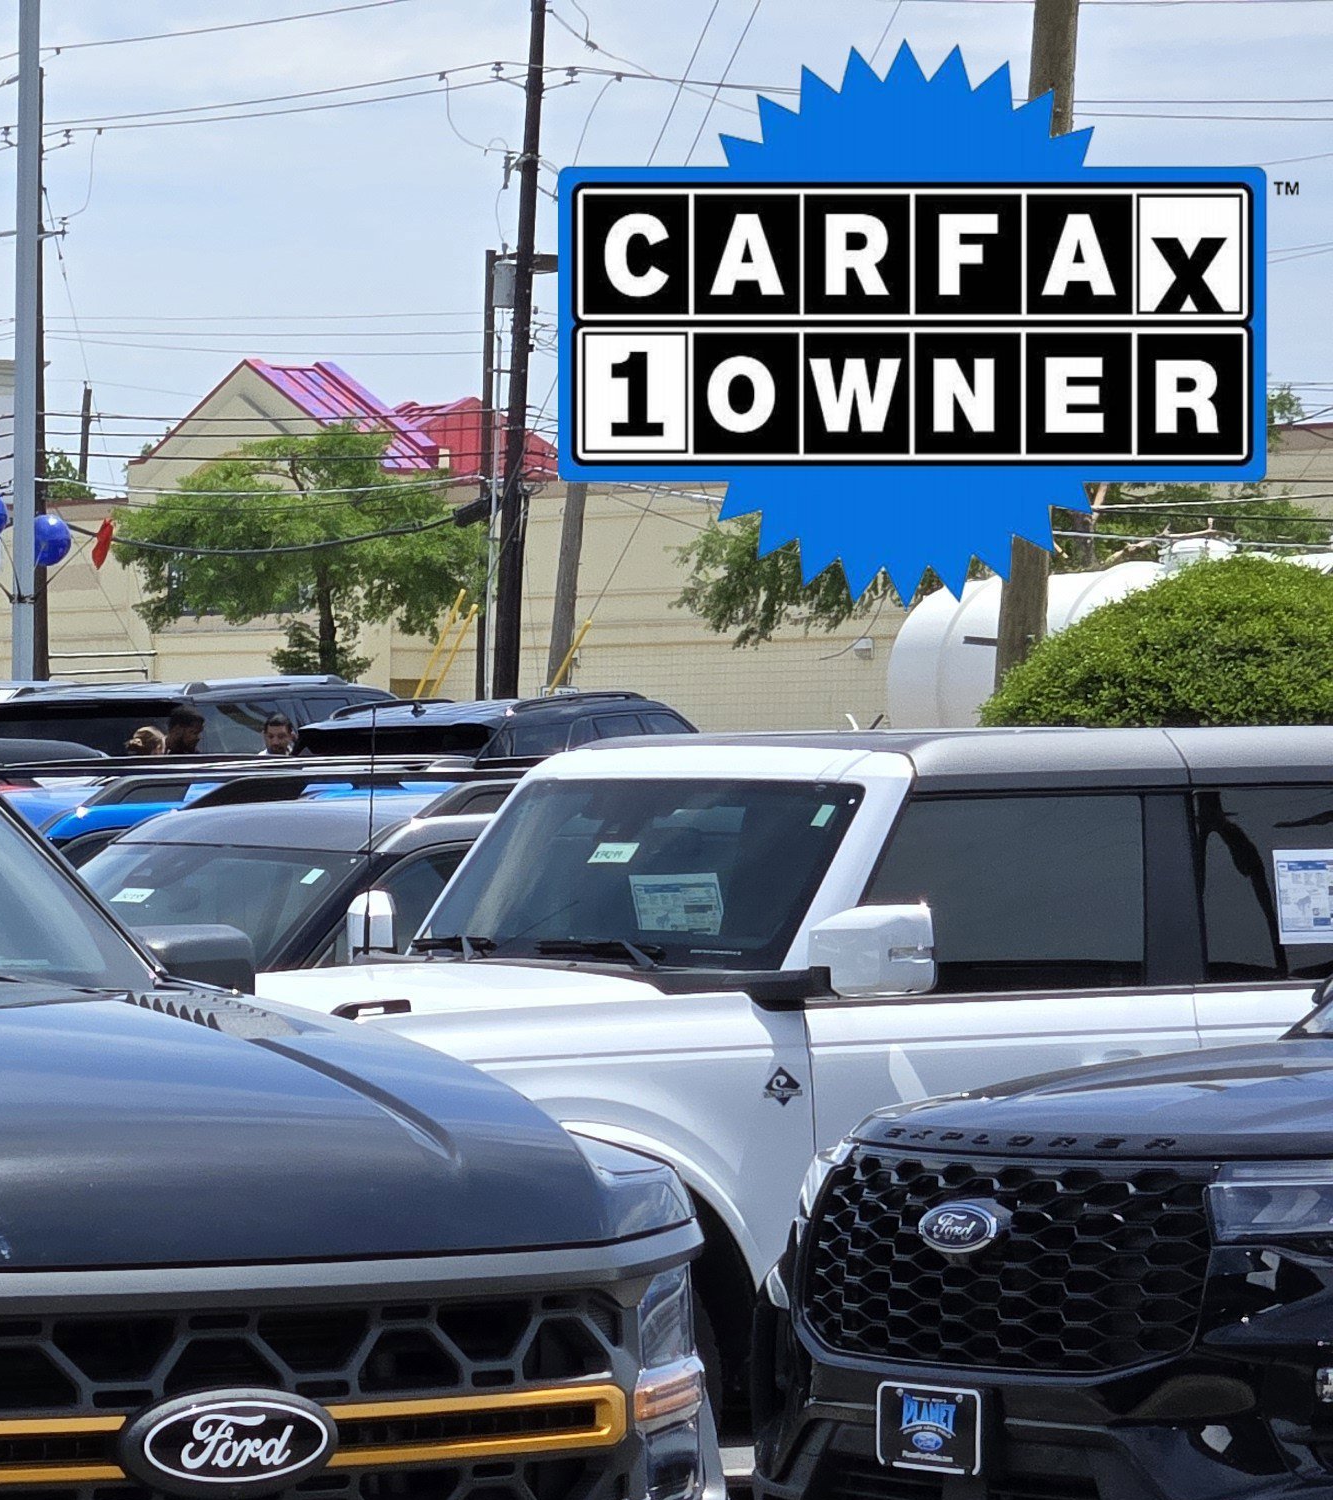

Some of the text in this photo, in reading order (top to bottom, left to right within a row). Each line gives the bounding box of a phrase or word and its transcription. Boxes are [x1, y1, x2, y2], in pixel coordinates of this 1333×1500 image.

[883, 1127, 1178, 1150] EXPLORER
[931, 1211, 977, 1241] Ford
[901, 1392, 957, 1433] PLANET
[180, 1413, 295, 1470] Ford
